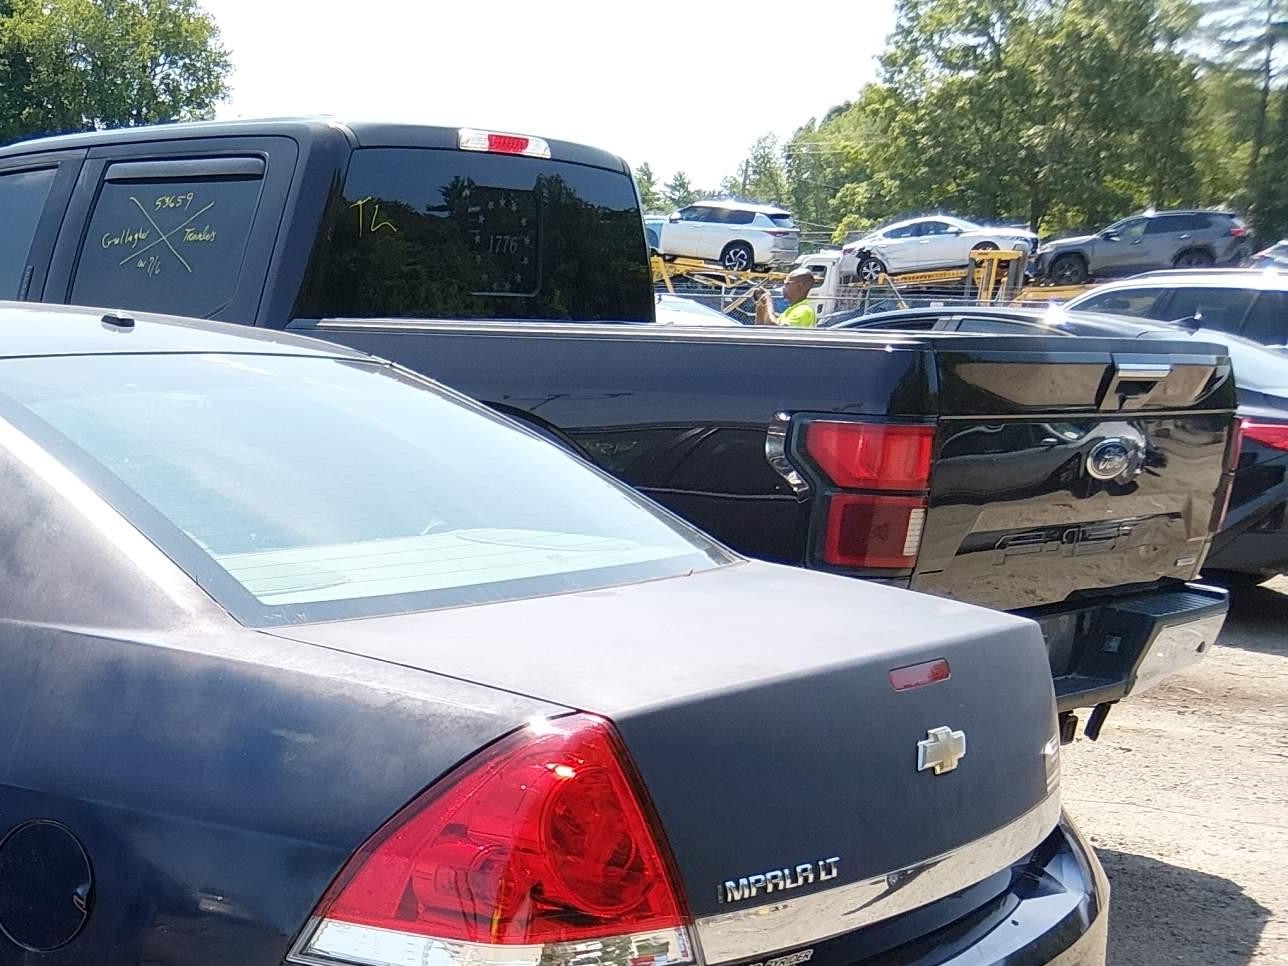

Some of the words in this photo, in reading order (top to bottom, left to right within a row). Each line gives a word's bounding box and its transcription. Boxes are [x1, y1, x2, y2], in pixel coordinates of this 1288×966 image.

[154, 192, 194, 211] 53659
[488, 234, 519, 254] 1776
[716, 862, 815, 904] IMPALA
[818, 856, 841, 881] LT
